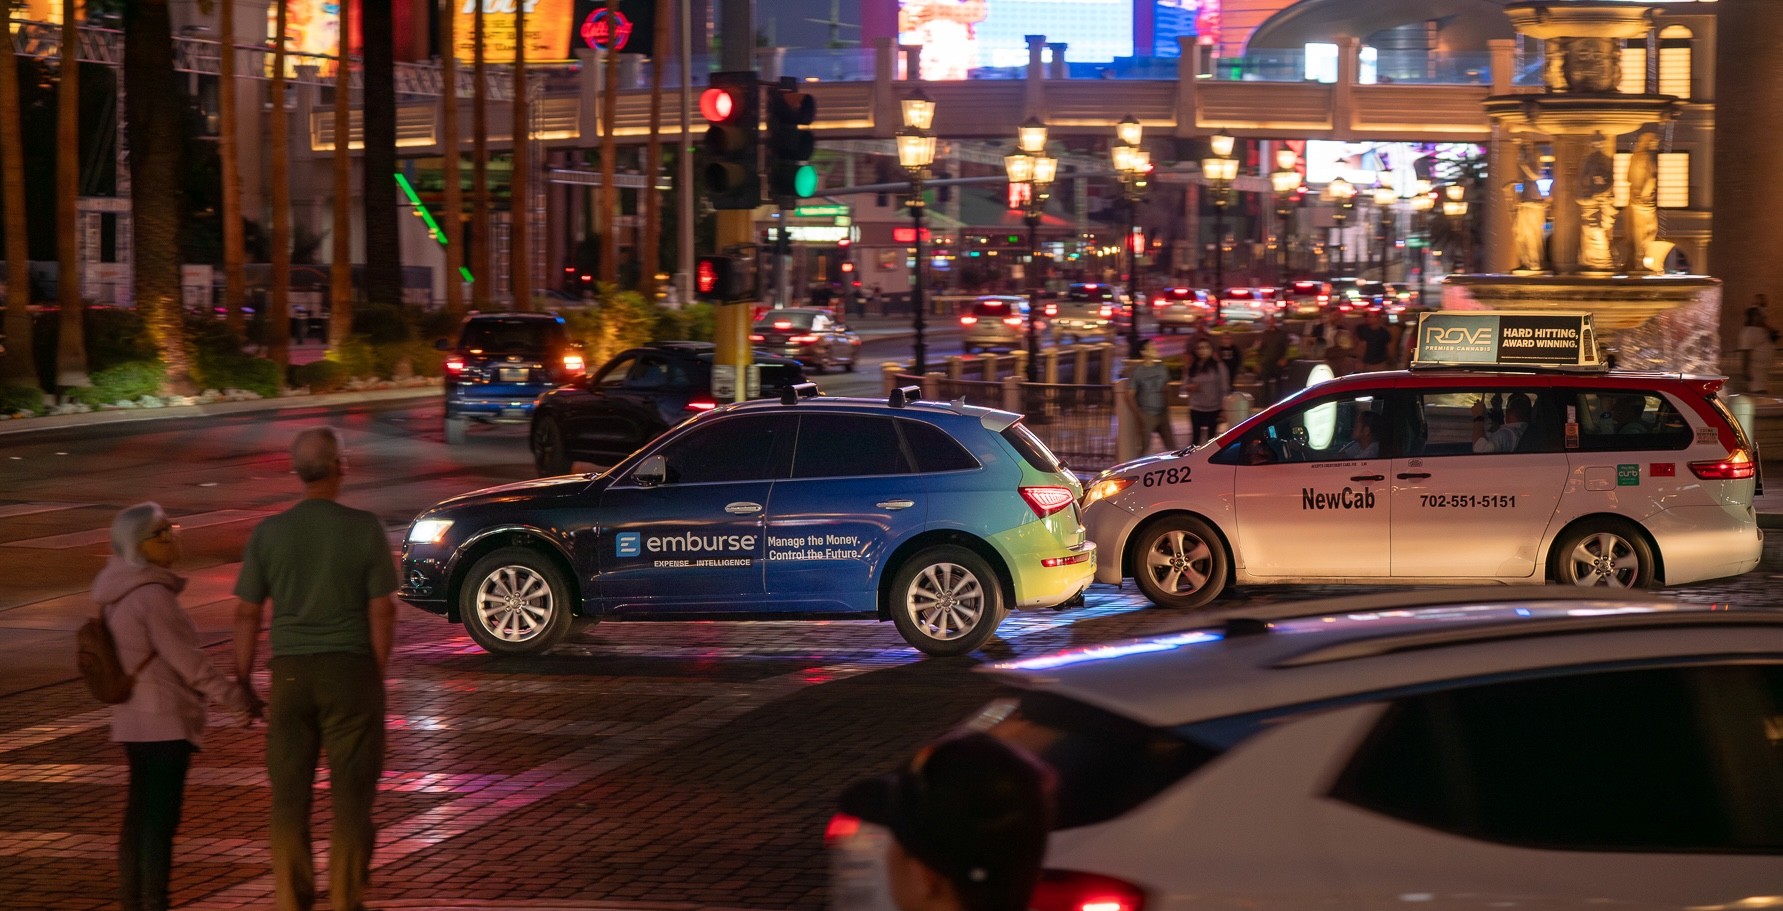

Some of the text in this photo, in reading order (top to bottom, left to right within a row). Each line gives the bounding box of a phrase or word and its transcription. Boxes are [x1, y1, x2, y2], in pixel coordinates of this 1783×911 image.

[1425, 327, 1492, 344] ROVE
[1503, 328, 1579, 340] HARD HITTING,
[1502, 339, 1578, 348] AWARD WINNING.
[1143, 466, 1192, 487] 6782
[1618, 469, 1638, 477] curb
[1302, 486, 1375, 510] NewCab
[1420, 495, 1516, 508] 702-551-5151
[768, 534, 860, 548] Manage the Money.
[769, 548, 860, 560] Control the Future.
[696, 559, 751, 567] INTELLIGENCE
